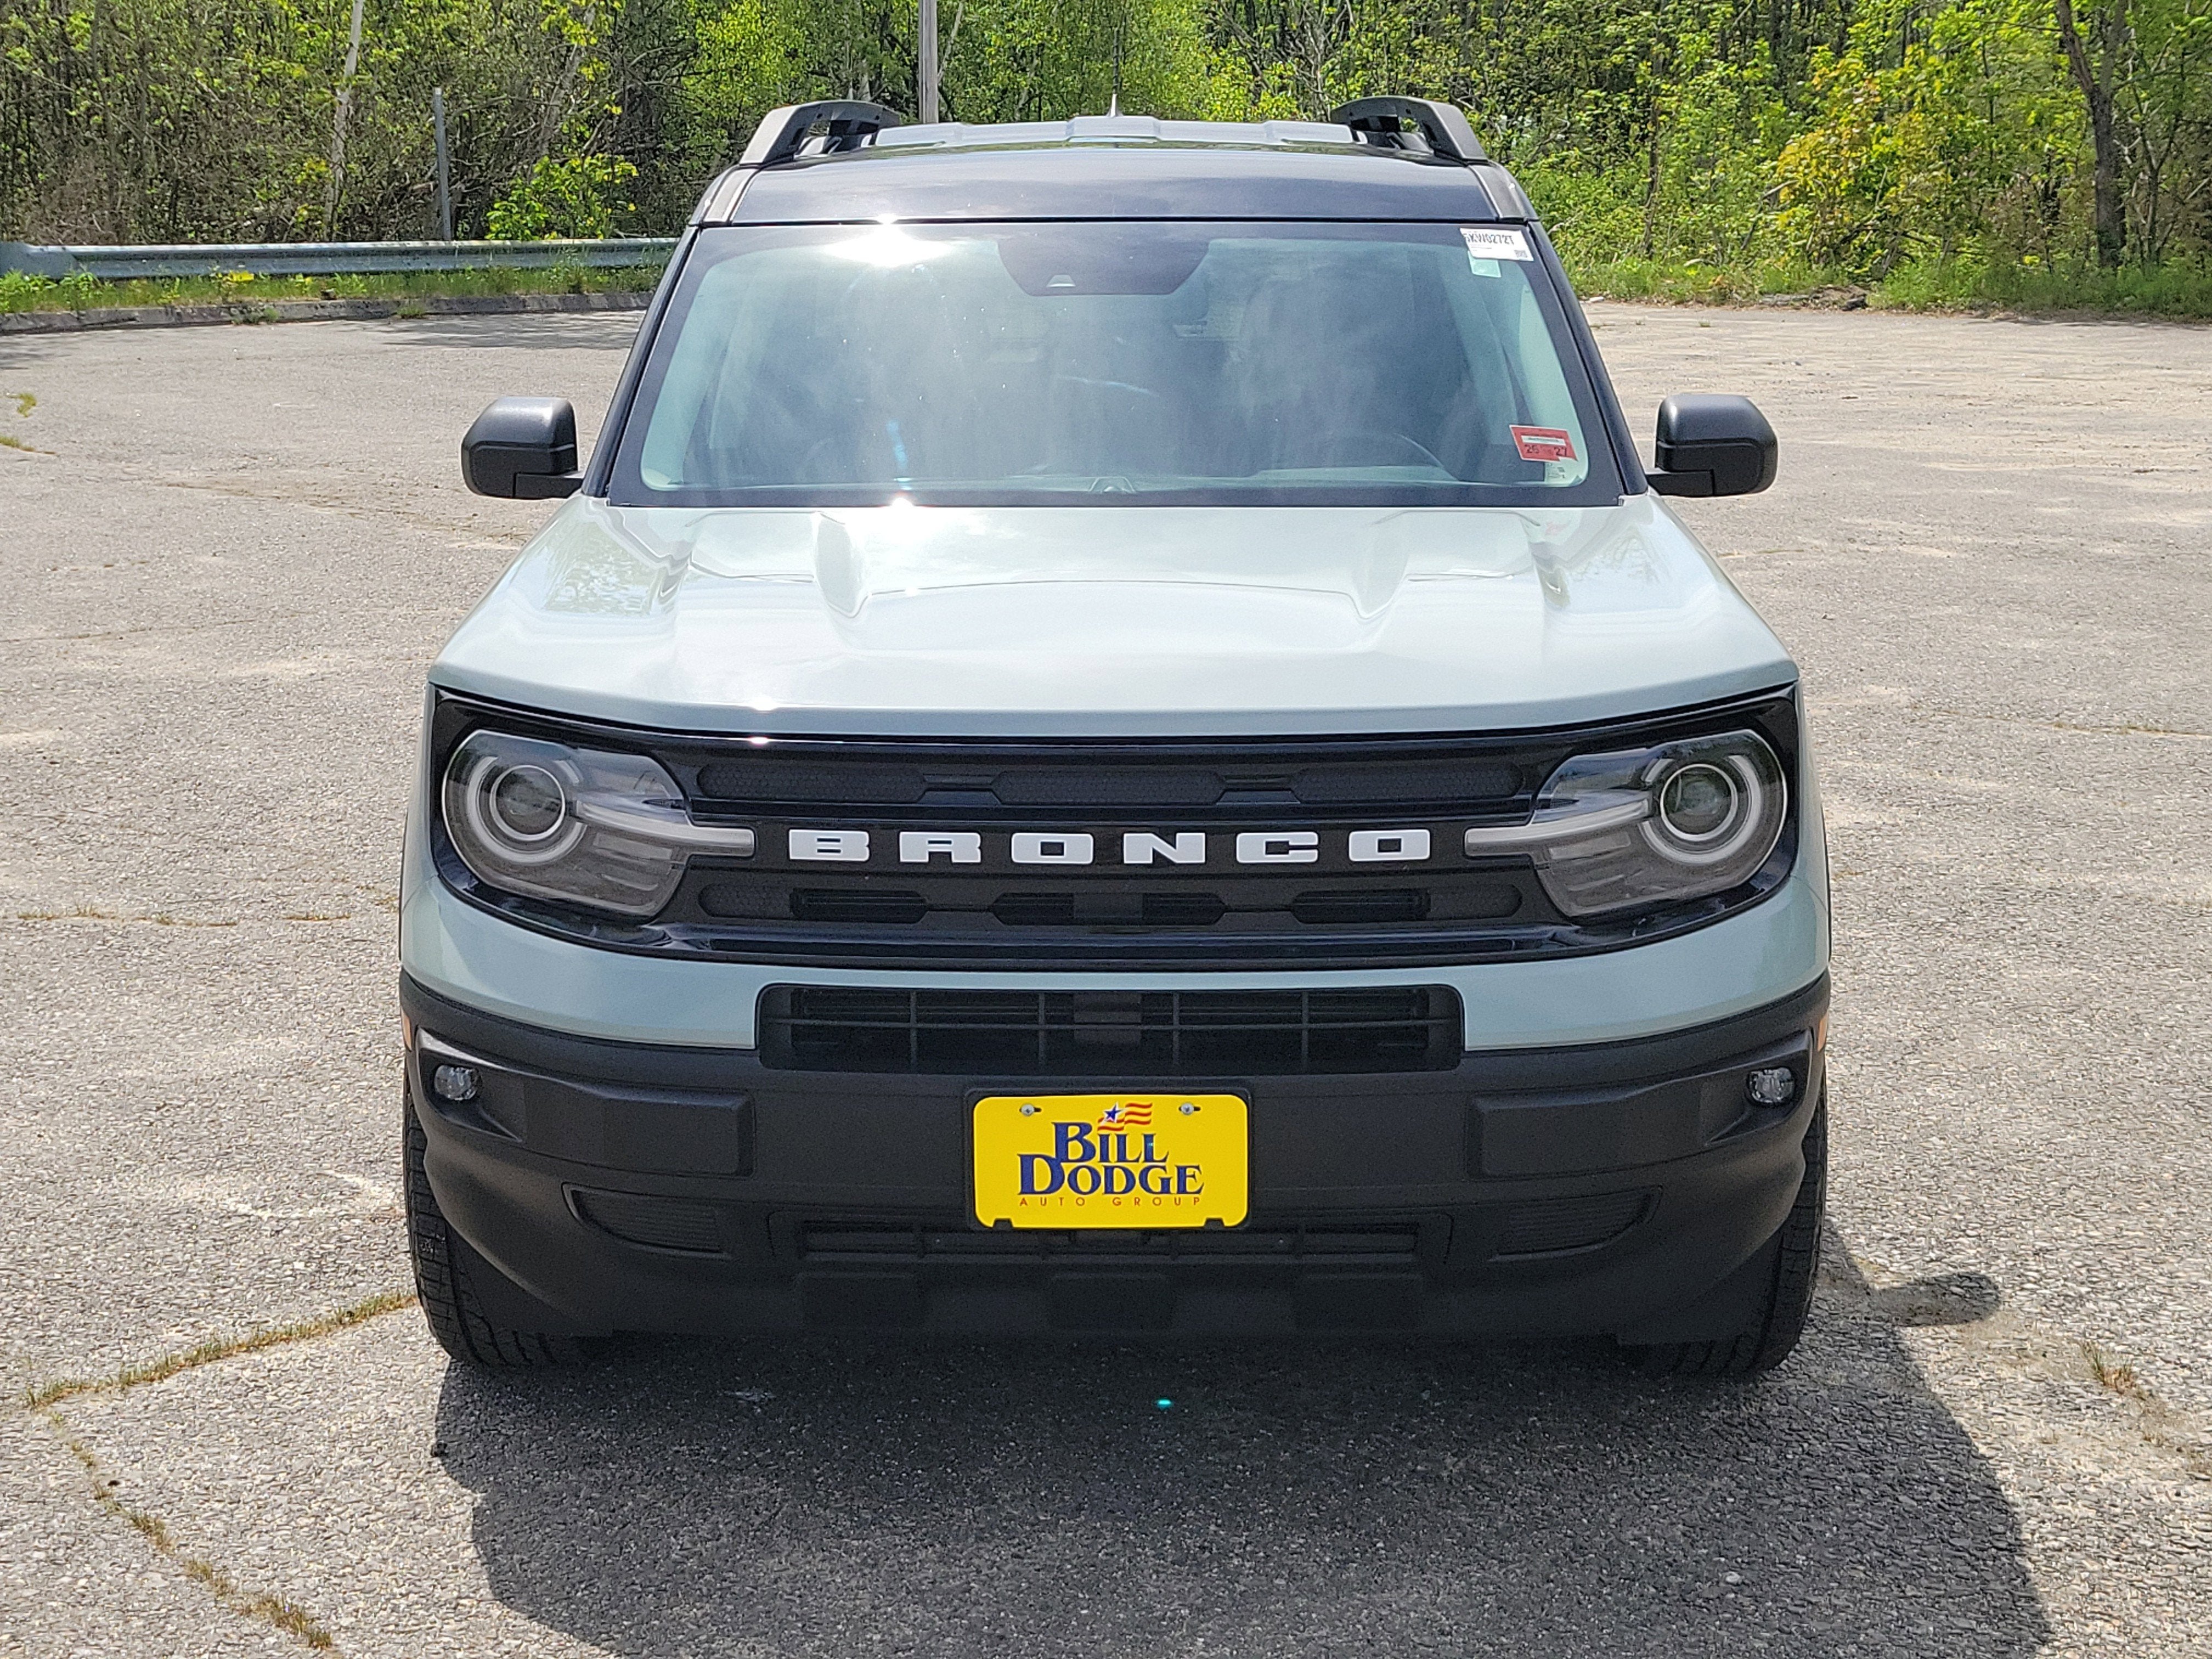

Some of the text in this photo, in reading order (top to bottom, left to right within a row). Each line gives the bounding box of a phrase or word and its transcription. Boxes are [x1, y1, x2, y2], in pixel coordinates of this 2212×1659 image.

[789, 829, 1430, 864] BRONCO
[1051, 1121, 1169, 1163] BILL
[1017, 1153, 1204, 1195] DODGE
[1019, 1197, 1200, 1206] AUTO GROUP
